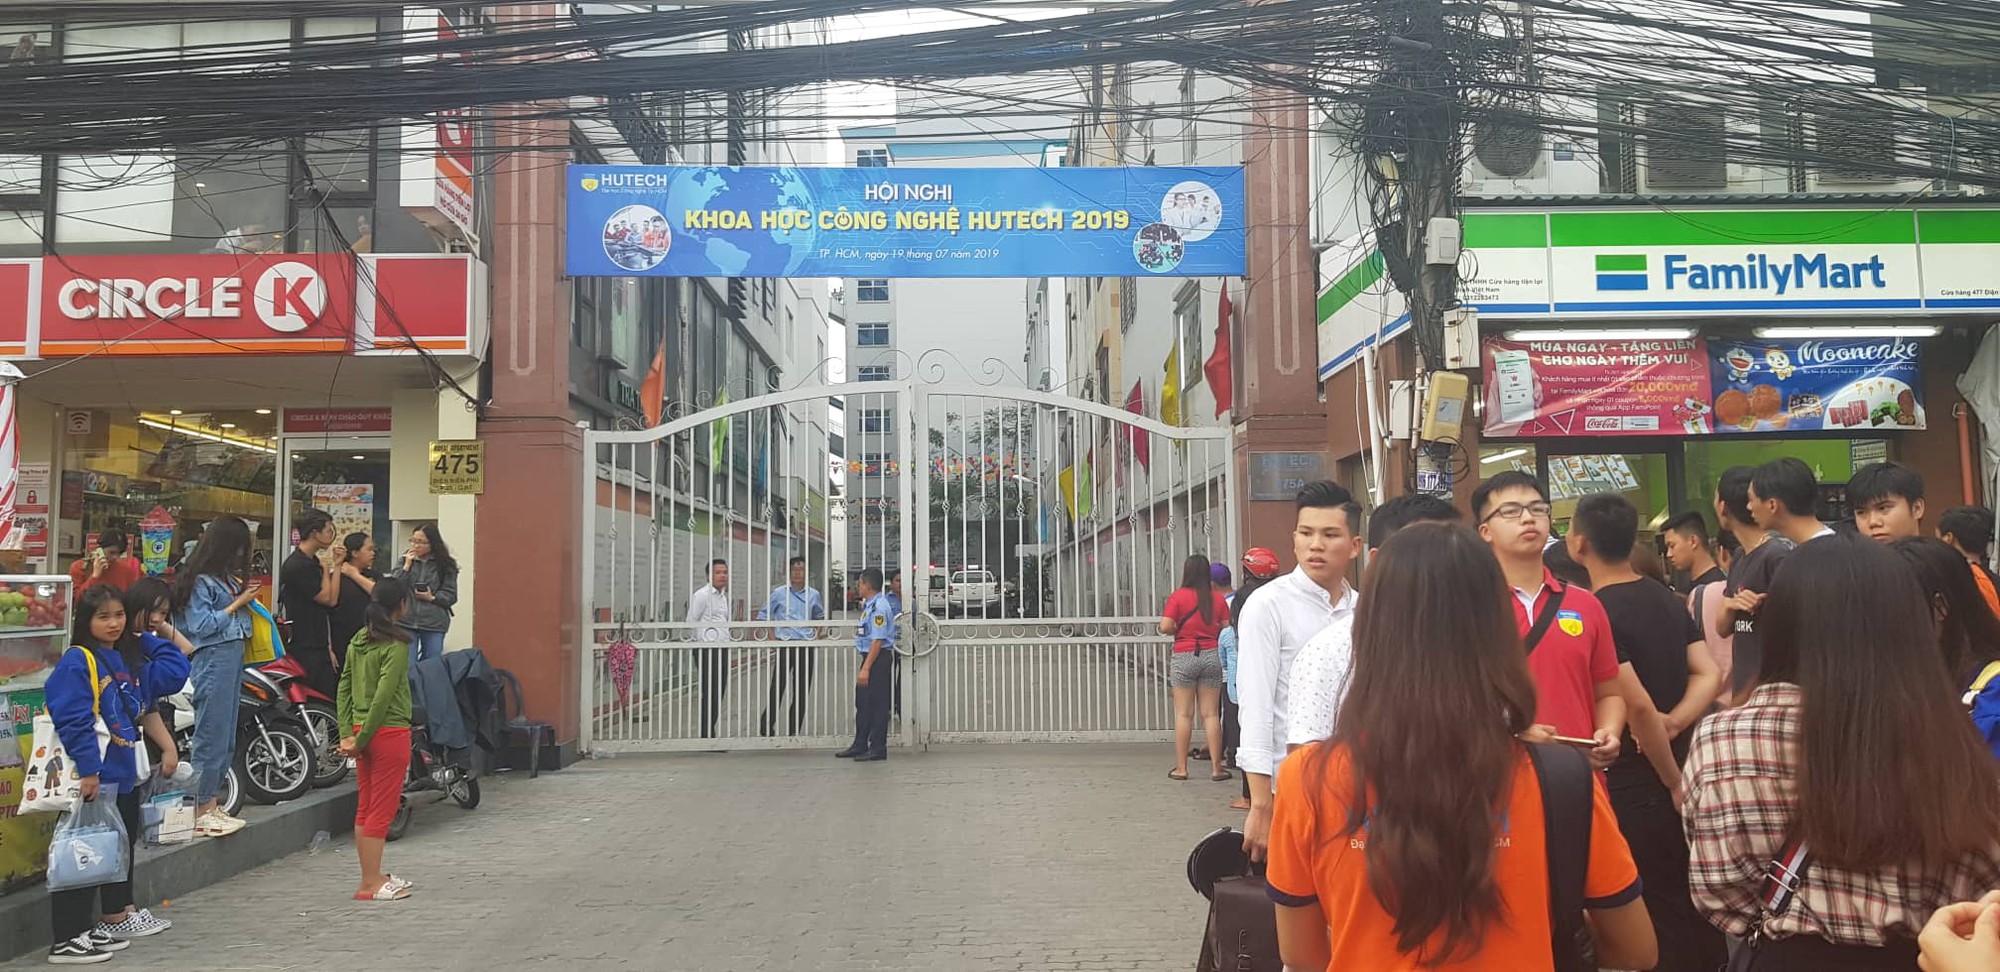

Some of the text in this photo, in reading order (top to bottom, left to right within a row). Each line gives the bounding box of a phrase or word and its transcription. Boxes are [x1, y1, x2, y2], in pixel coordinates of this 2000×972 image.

[602, 174, 667, 186] HUTECH
[865, 181, 952, 204] HỘI NGHỊ
[685, 206, 1130, 235] KHOA HỌC CÔNG NGHỆ HUTECH 2019
[892, 249, 905, 258] 19
[935, 249, 948, 258] 07
[974, 249, 999, 258] 2019
[1664, 253, 1886, 295] FamilyMart
[58, 274, 321, 328] CIRCLE K
[1530, 341, 1563, 353] MUA
[1567, 342, 1607, 354] NGAY
[1797, 337, 1918, 364] Mooncake
[1576, 353, 1618, 366] NGÀY
[1621, 352, 1660, 366] THÊM
[1663, 353, 1688, 364] VUI
[435, 454, 479, 474] 475
[1350, 838, 1365, 850] Đạ
